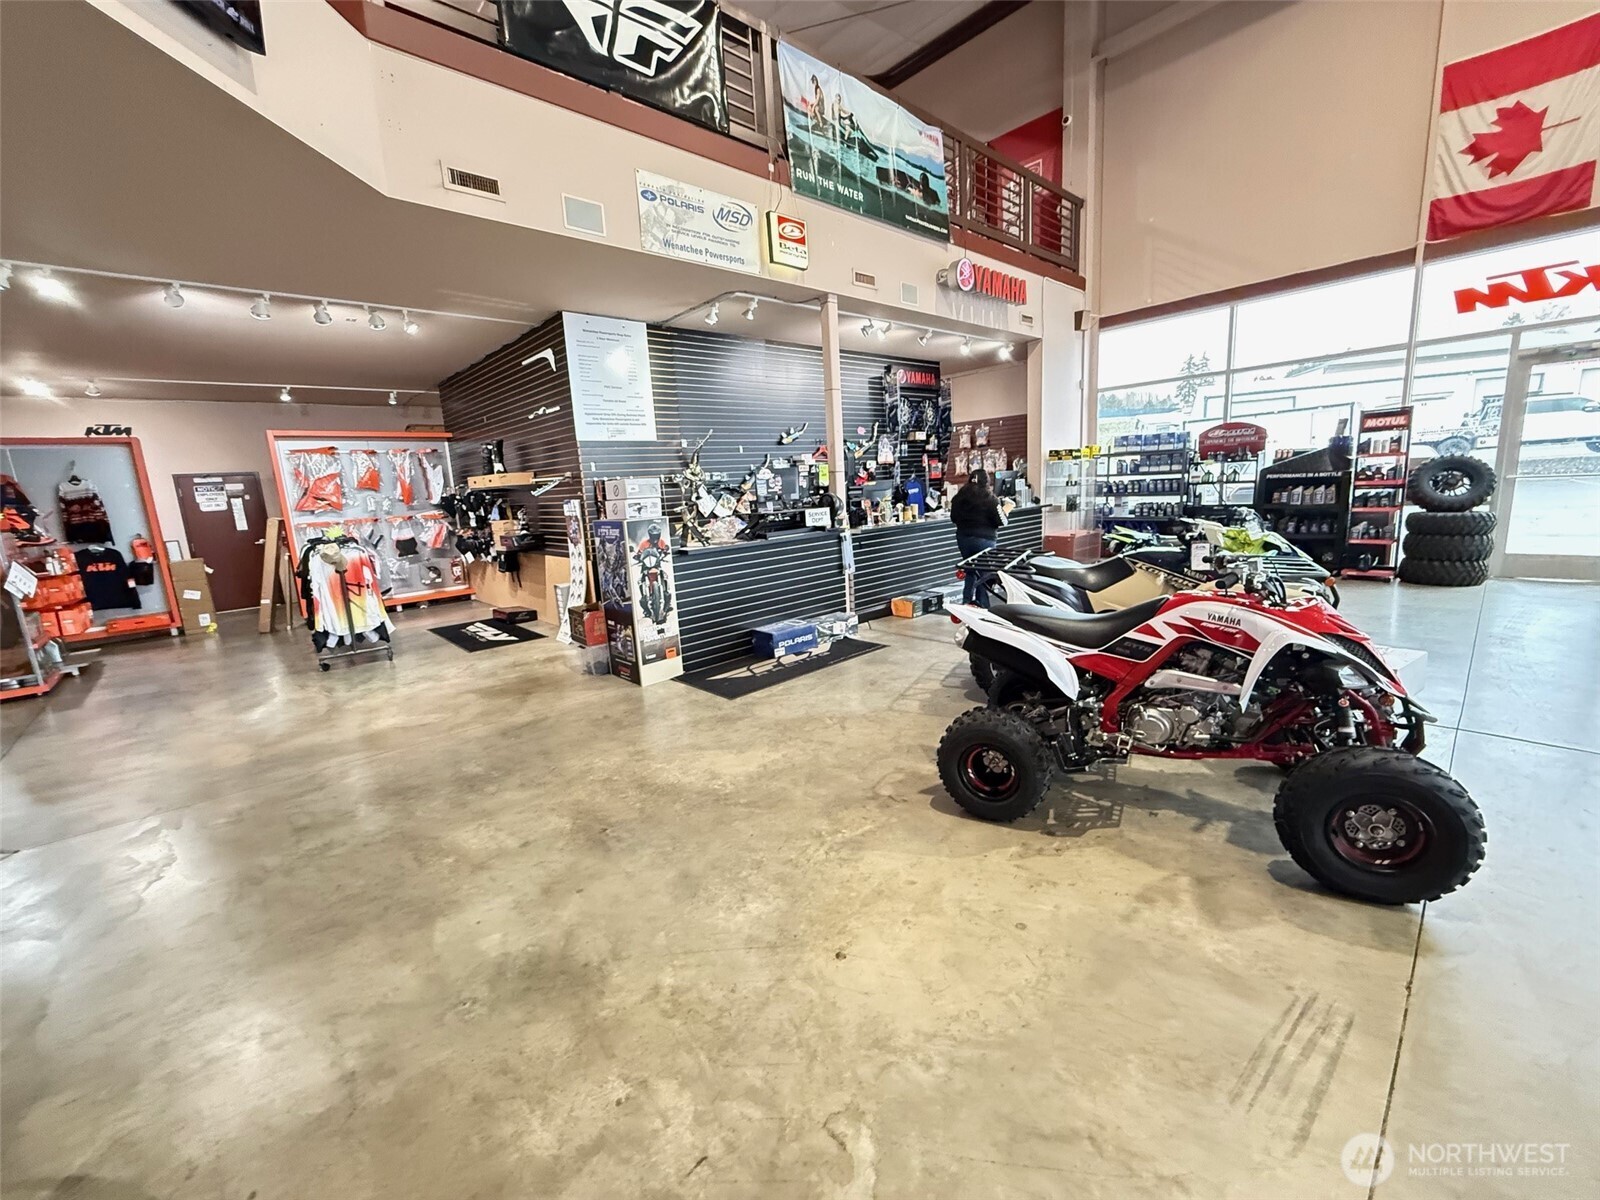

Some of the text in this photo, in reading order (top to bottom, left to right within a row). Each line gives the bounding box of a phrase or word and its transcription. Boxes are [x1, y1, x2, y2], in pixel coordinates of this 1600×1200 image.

[796, 167, 864, 202] RUN THE WATER
[660, 194, 705, 214] POLARIS
[716, 207, 751, 227] MSD
[662, 238, 745, 265] Wenatchee Powersports
[779, 241, 807, 255] Beta
[973, 264, 1027, 305] YAMAHA
[906, 370, 936, 386] YAMAHA
[1363, 415, 1406, 428] MOTUL
[84, 424, 132, 436] KTM
[86, 562, 117, 572] KTM
[1207, 612, 1241, 626] YAMAHA
[779, 633, 813, 648] POLARIS
